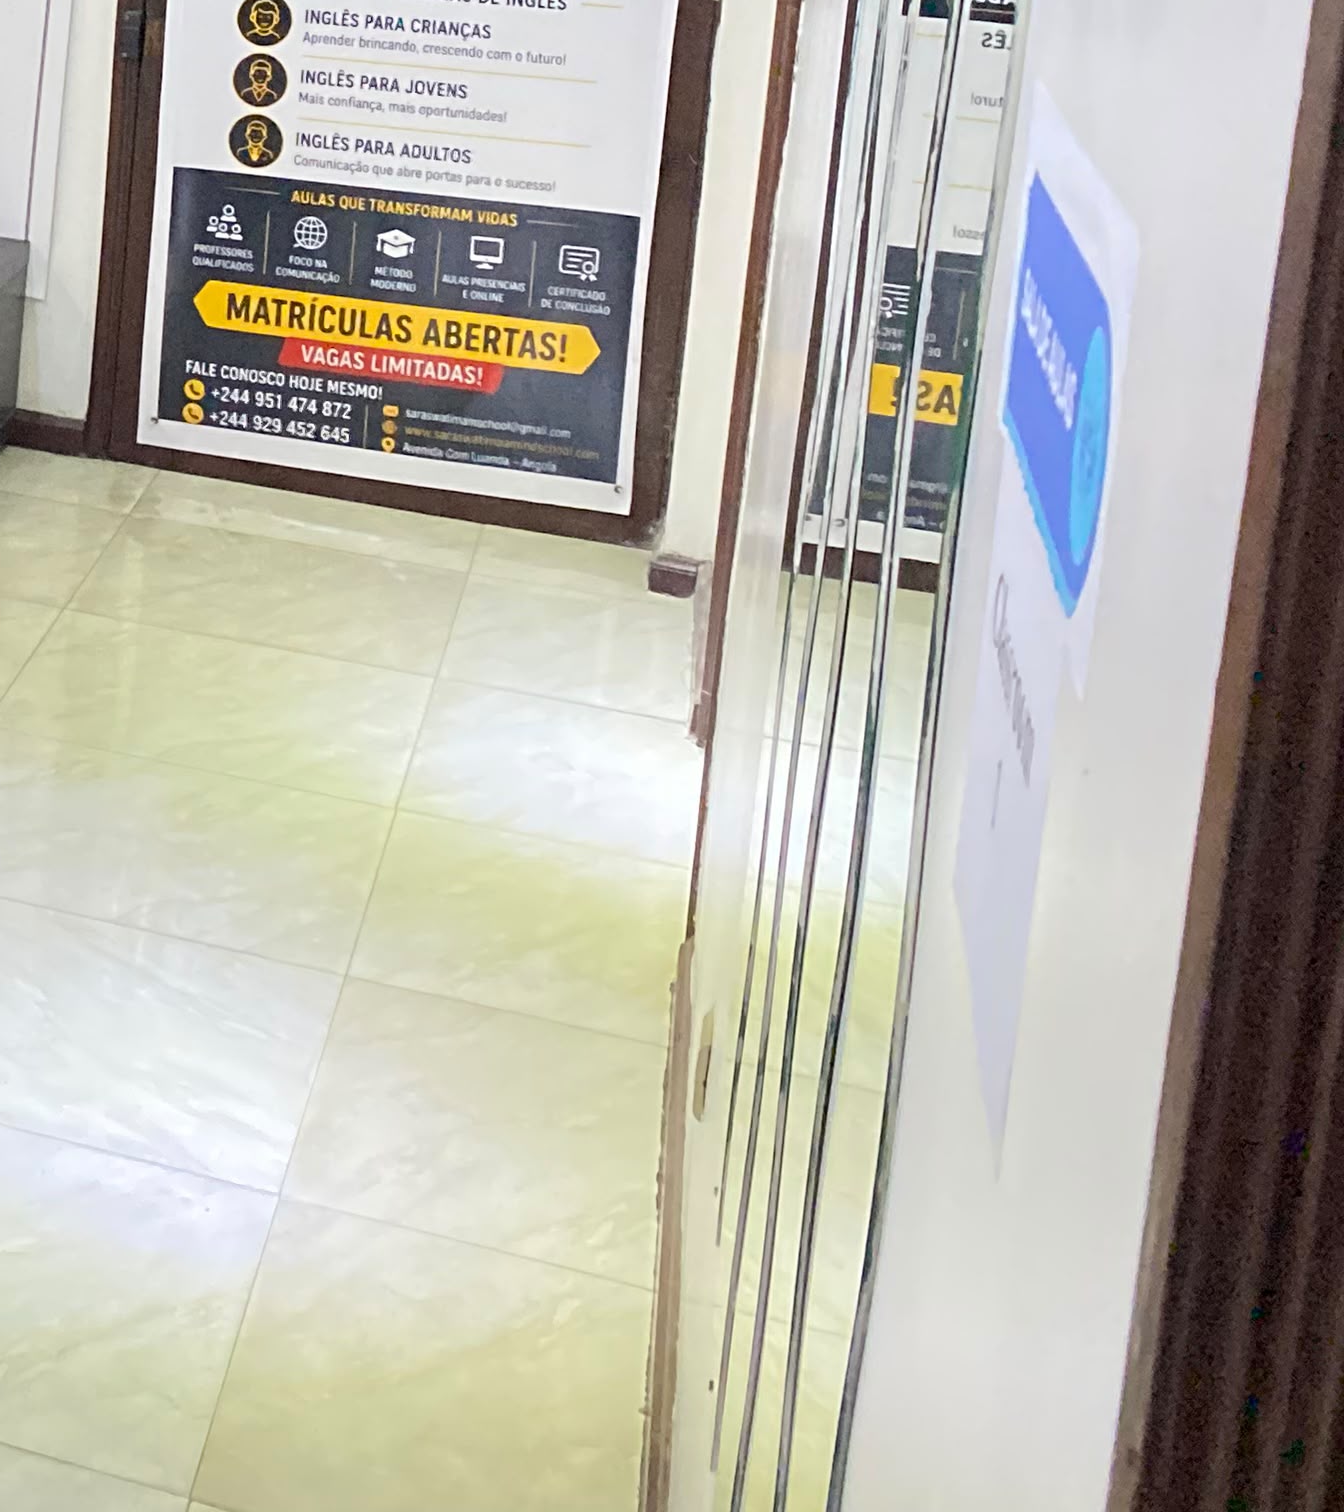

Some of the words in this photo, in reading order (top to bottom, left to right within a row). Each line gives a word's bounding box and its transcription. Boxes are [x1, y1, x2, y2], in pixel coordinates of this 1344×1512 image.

[304, 9, 359, 28] INGLÊS
[364, 14, 405, 32] PARA
[411, 18, 492, 41] CRIANÇAS
[302, 32, 355, 48] Aprender
[422, 43, 483, 58] crescendo
[486, 49, 512, 61] com
[515, 53, 523, 62] o
[526, 51, 567, 66] futuro!
[300, 69, 354, 88] INGLÊS
[360, 75, 400, 93] PARA
[405, 79, 469, 99] JOVENS
[298, 92, 325, 105] Mais
[388, 101, 416, 114] mais
[418, 103, 507, 123] oportunidades!
[296, 132, 349, 151] INGLÊS
[355, 139, 395, 156] PARA
[400, 143, 472, 164] ADULTOS
[293, 155, 369, 175] Comunicação
[372, 164, 394, 178] que
[396, 166, 422, 179] abre
[425, 168, 462, 184] portas
[465, 173, 491, 187] para
[494, 178, 502, 187] o
[505, 178, 557, 193] sucesso!
[291, 190, 335, 207] AULAS
[339, 195, 366, 211] QUE
[370, 199, 473, 223] TRANSFORMAM
[477, 210, 519, 228] VIDAS
[192, 256, 255, 273] QUALIFICADOS
[193, 244, 253, 259] PROFESSORES
[288, 255, 313, 267] FOCO
[315, 258, 328, 268] NA
[442, 273, 470, 286] AULAS
[547, 286, 606, 302] CERTIFICADO
[469, 291, 505, 303] ONLINE
[540, 298, 553, 309] DE
[226, 292, 412, 344] MATRÍCULAS
[422, 318, 568, 363] ABERTAS!
[185, 359, 216, 377] FALE
[221, 365, 285, 386] CONOSCO
[289, 376, 323, 392] HOJE
[327, 380, 383, 400] MESMO!
[301, 345, 365, 370] VAGAS
[370, 354, 484, 387] LIMITADAS!
[210, 387, 251, 404] +244
[255, 391, 282, 409] 951
[287, 396, 318, 415] 474
[321, 401, 352, 420] 872
[209, 410, 248, 429] +244
[252, 416, 282, 434] 929
[286, 421, 317, 439] 452
[320, 426, 351, 443] 645
